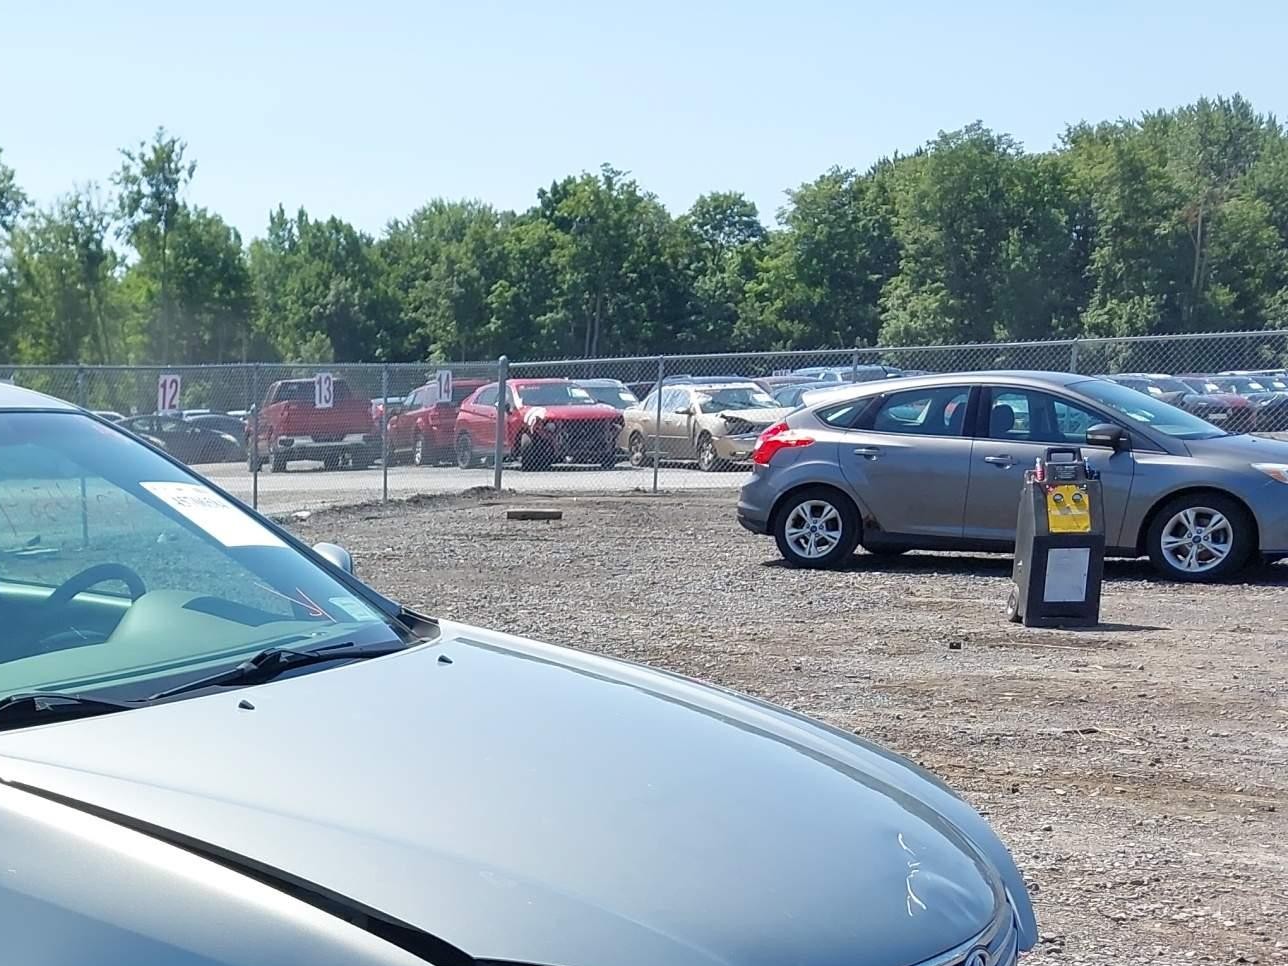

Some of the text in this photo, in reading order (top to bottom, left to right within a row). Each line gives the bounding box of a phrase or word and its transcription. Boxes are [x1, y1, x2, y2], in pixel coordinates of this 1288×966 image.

[160, 378, 178, 410] 12
[317, 375, 332, 404] 13
[437, 373, 450, 400] 14
